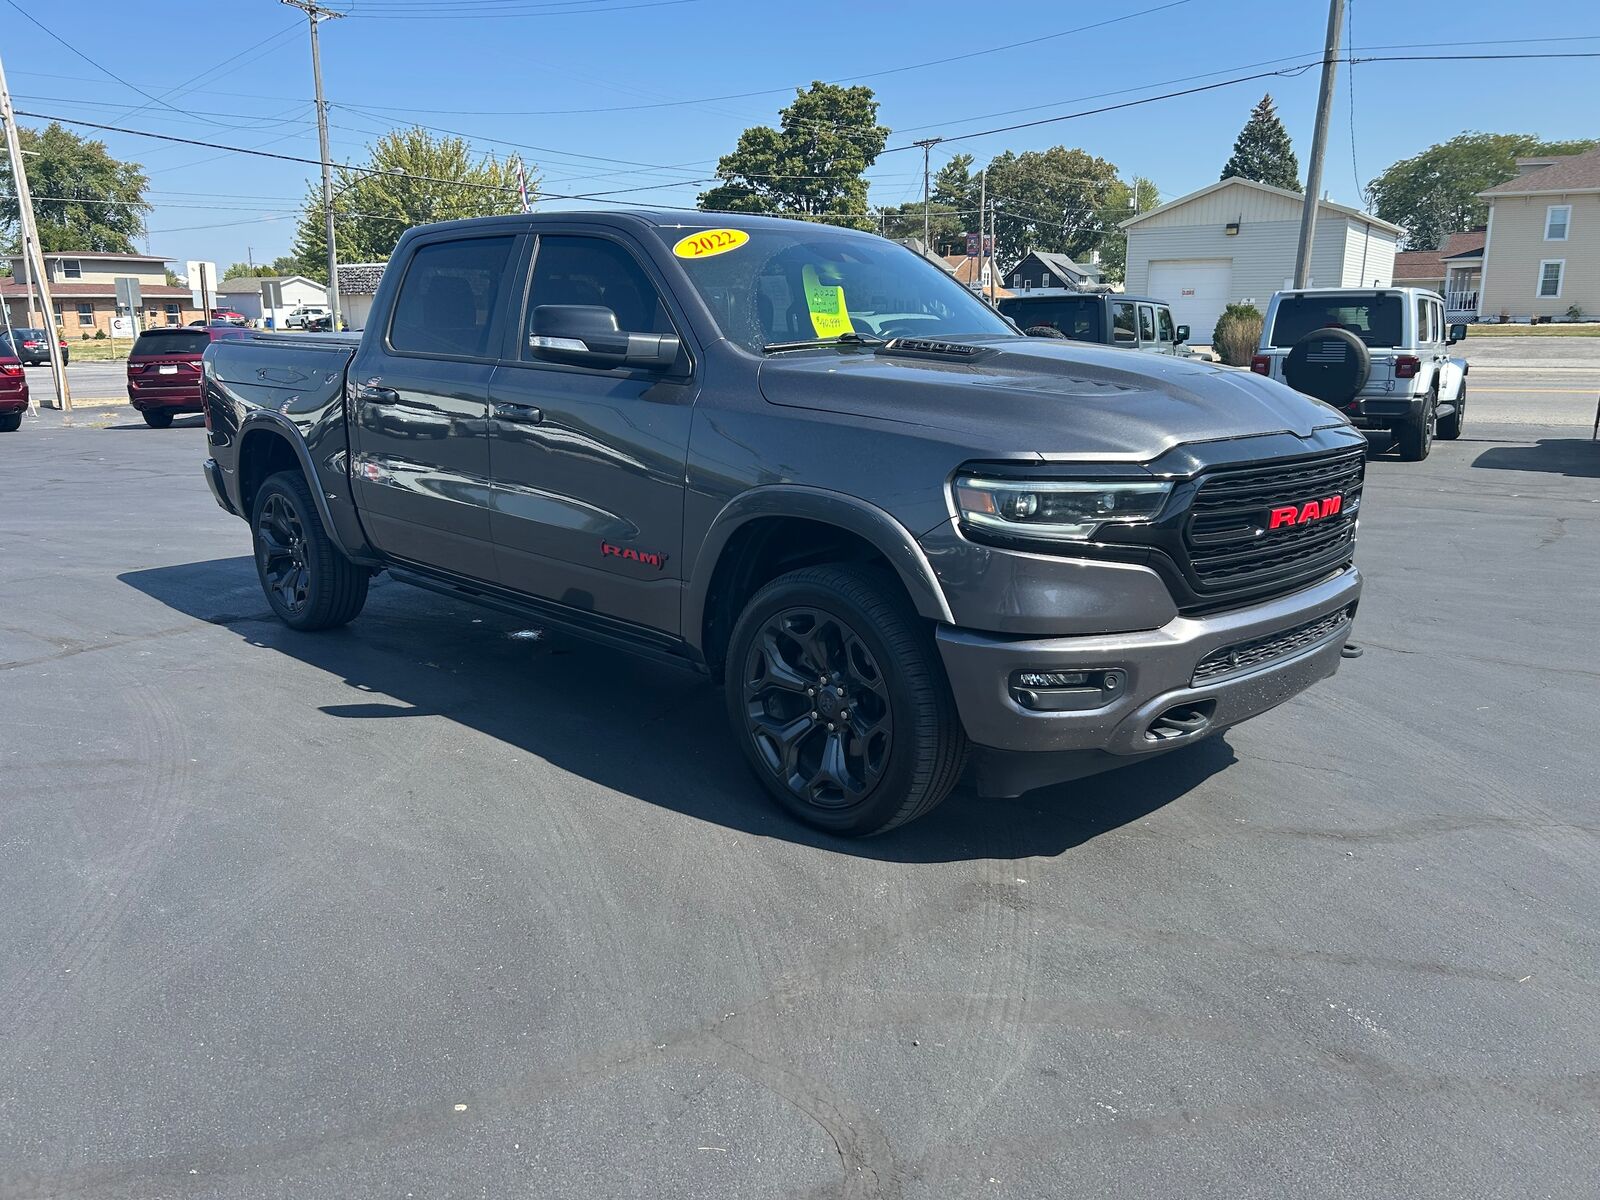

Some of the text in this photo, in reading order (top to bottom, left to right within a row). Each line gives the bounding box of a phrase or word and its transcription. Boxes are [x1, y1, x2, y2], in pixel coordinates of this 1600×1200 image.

[687, 231, 737, 256] 2022
[1268, 495, 1342, 530] RAM
[602, 542, 659, 567] RAM
